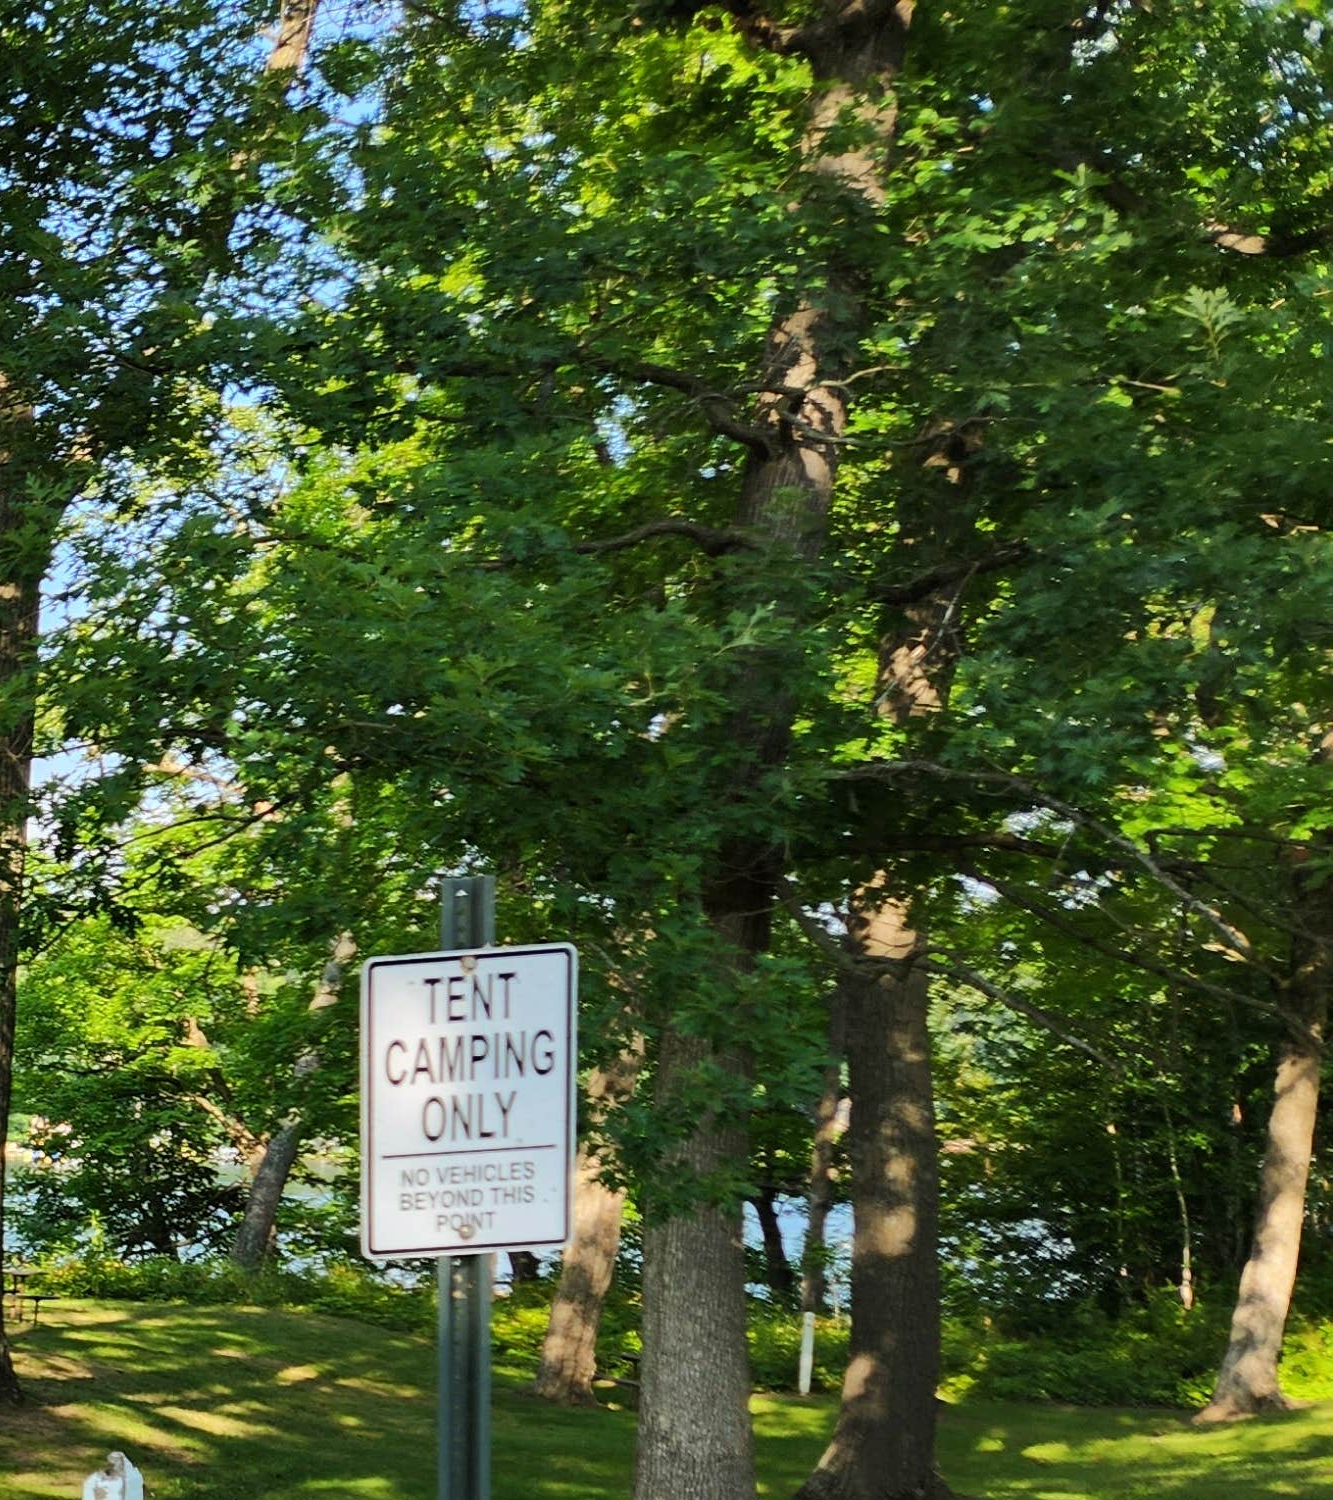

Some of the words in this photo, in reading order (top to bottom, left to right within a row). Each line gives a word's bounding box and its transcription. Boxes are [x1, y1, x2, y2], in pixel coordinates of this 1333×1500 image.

[423, 972, 516, 1024] TENT
[386, 1030, 555, 1085] CAMPING
[422, 1091, 517, 1141] ONLY
[401, 1168, 430, 1187] NO
[436, 1162, 535, 1184] VEHICLES
[400, 1189, 483, 1211] BEYOND
[491, 1185, 535, 1204] THIS
[437, 1212, 496, 1232] POINT
